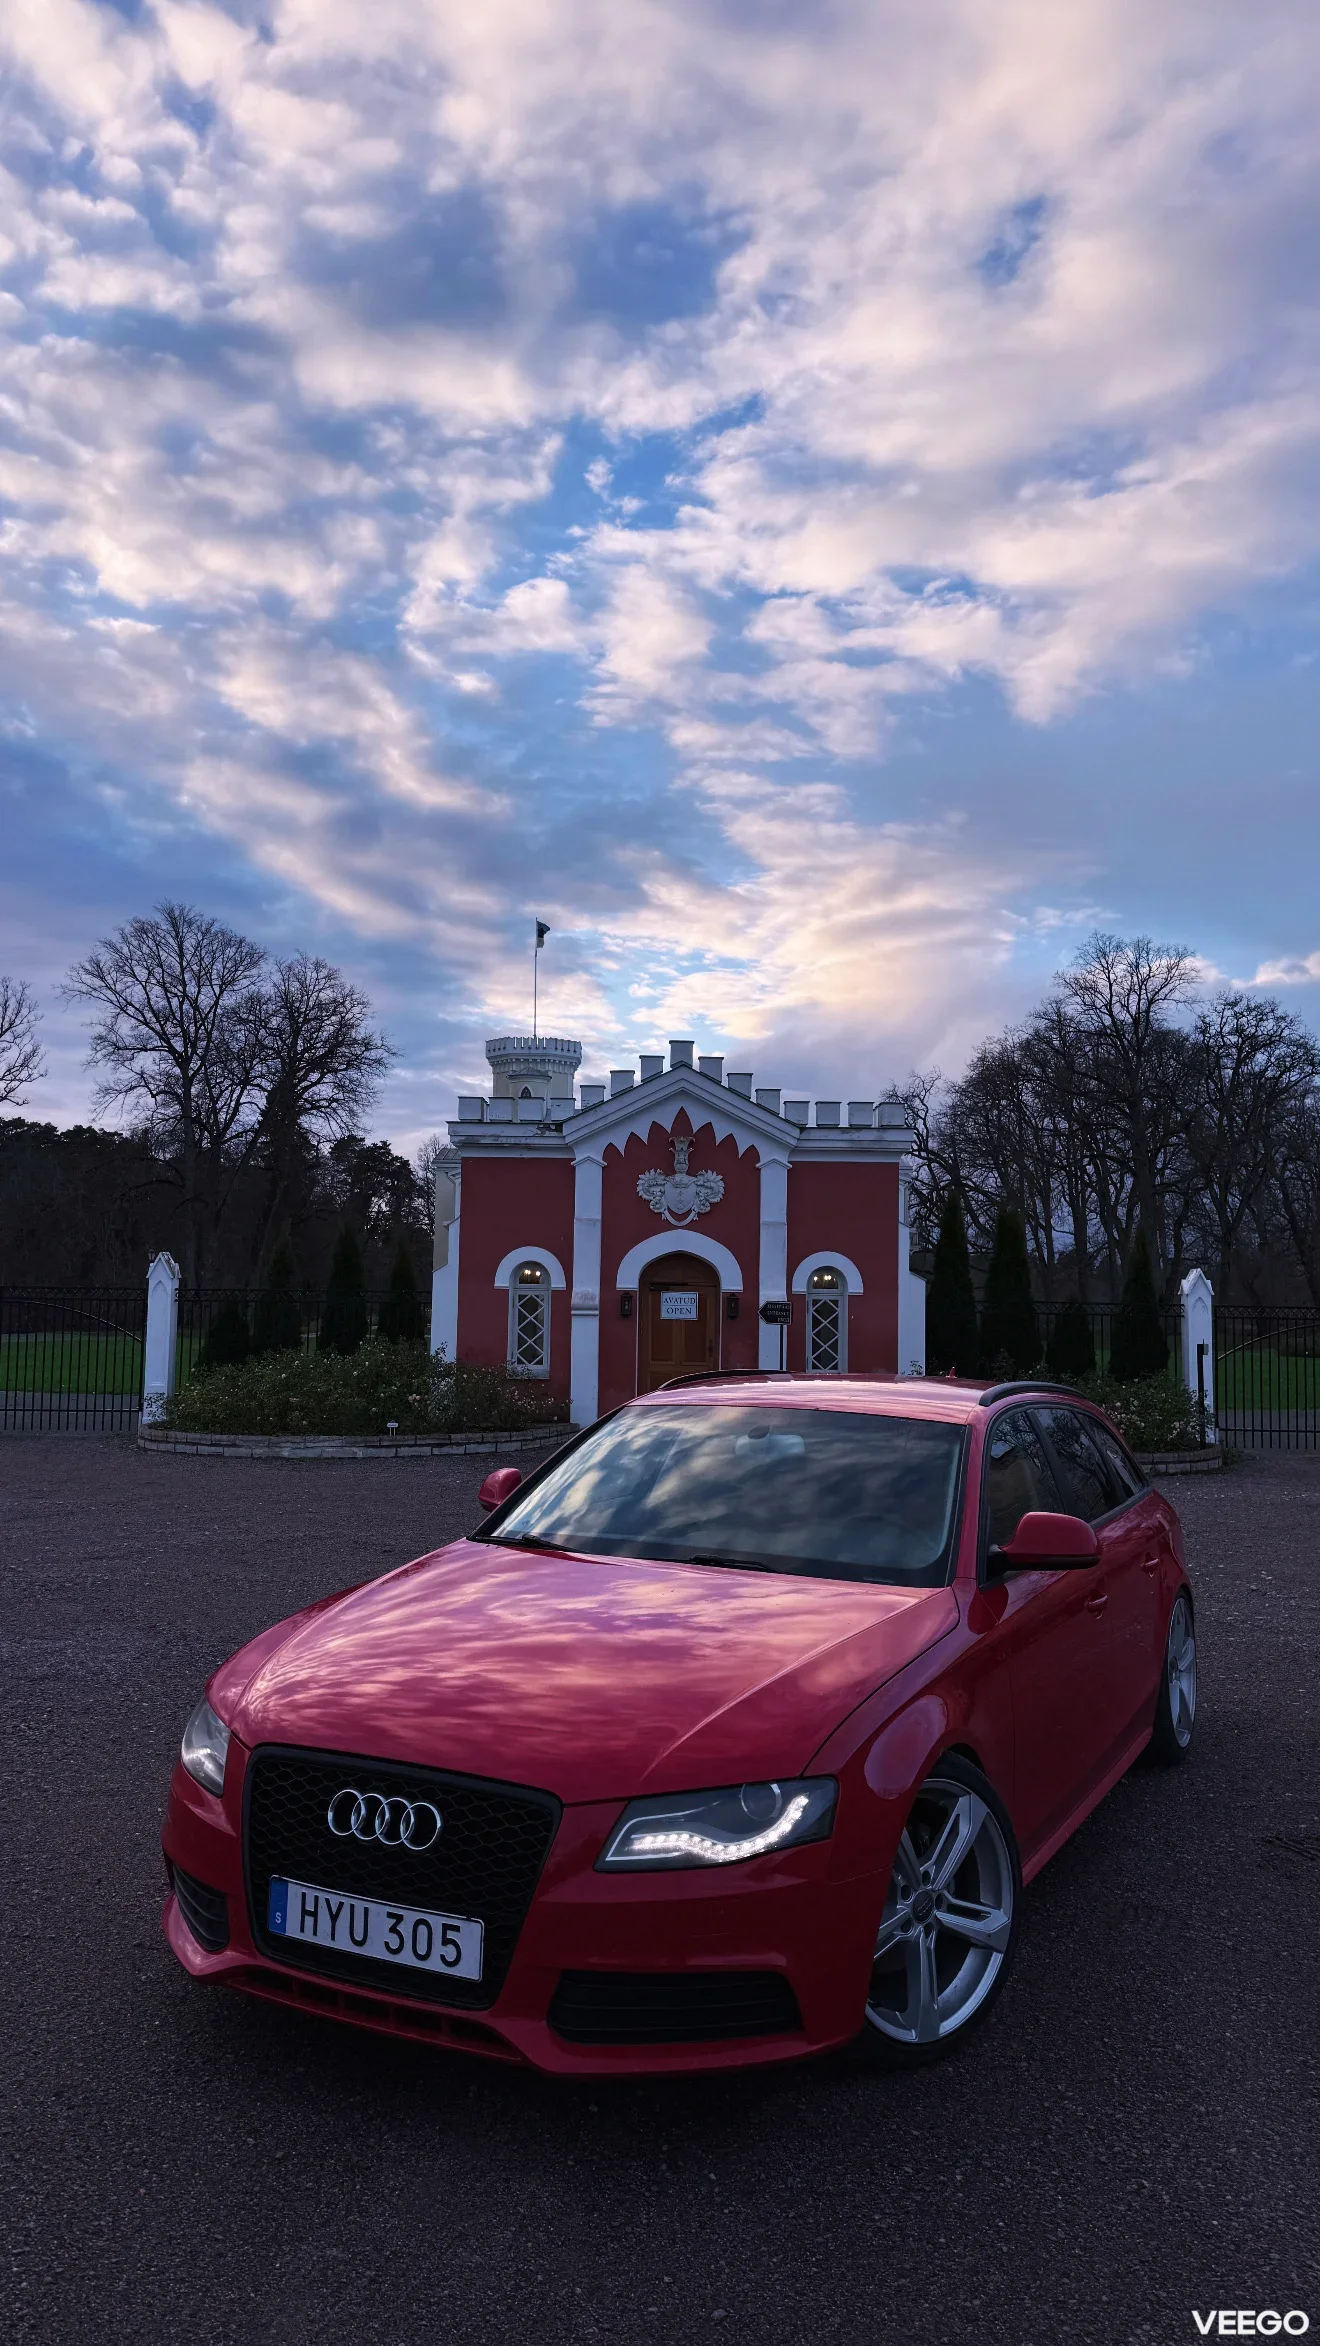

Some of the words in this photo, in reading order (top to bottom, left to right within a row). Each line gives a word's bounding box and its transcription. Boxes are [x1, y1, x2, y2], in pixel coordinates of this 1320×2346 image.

[663, 1297, 696, 1305] AVATUD
[666, 1307, 692, 1315] OPEN
[275, 1911, 282, 1924] S
[300, 1891, 370, 1947] HYU
[383, 1911, 462, 1968] 305
